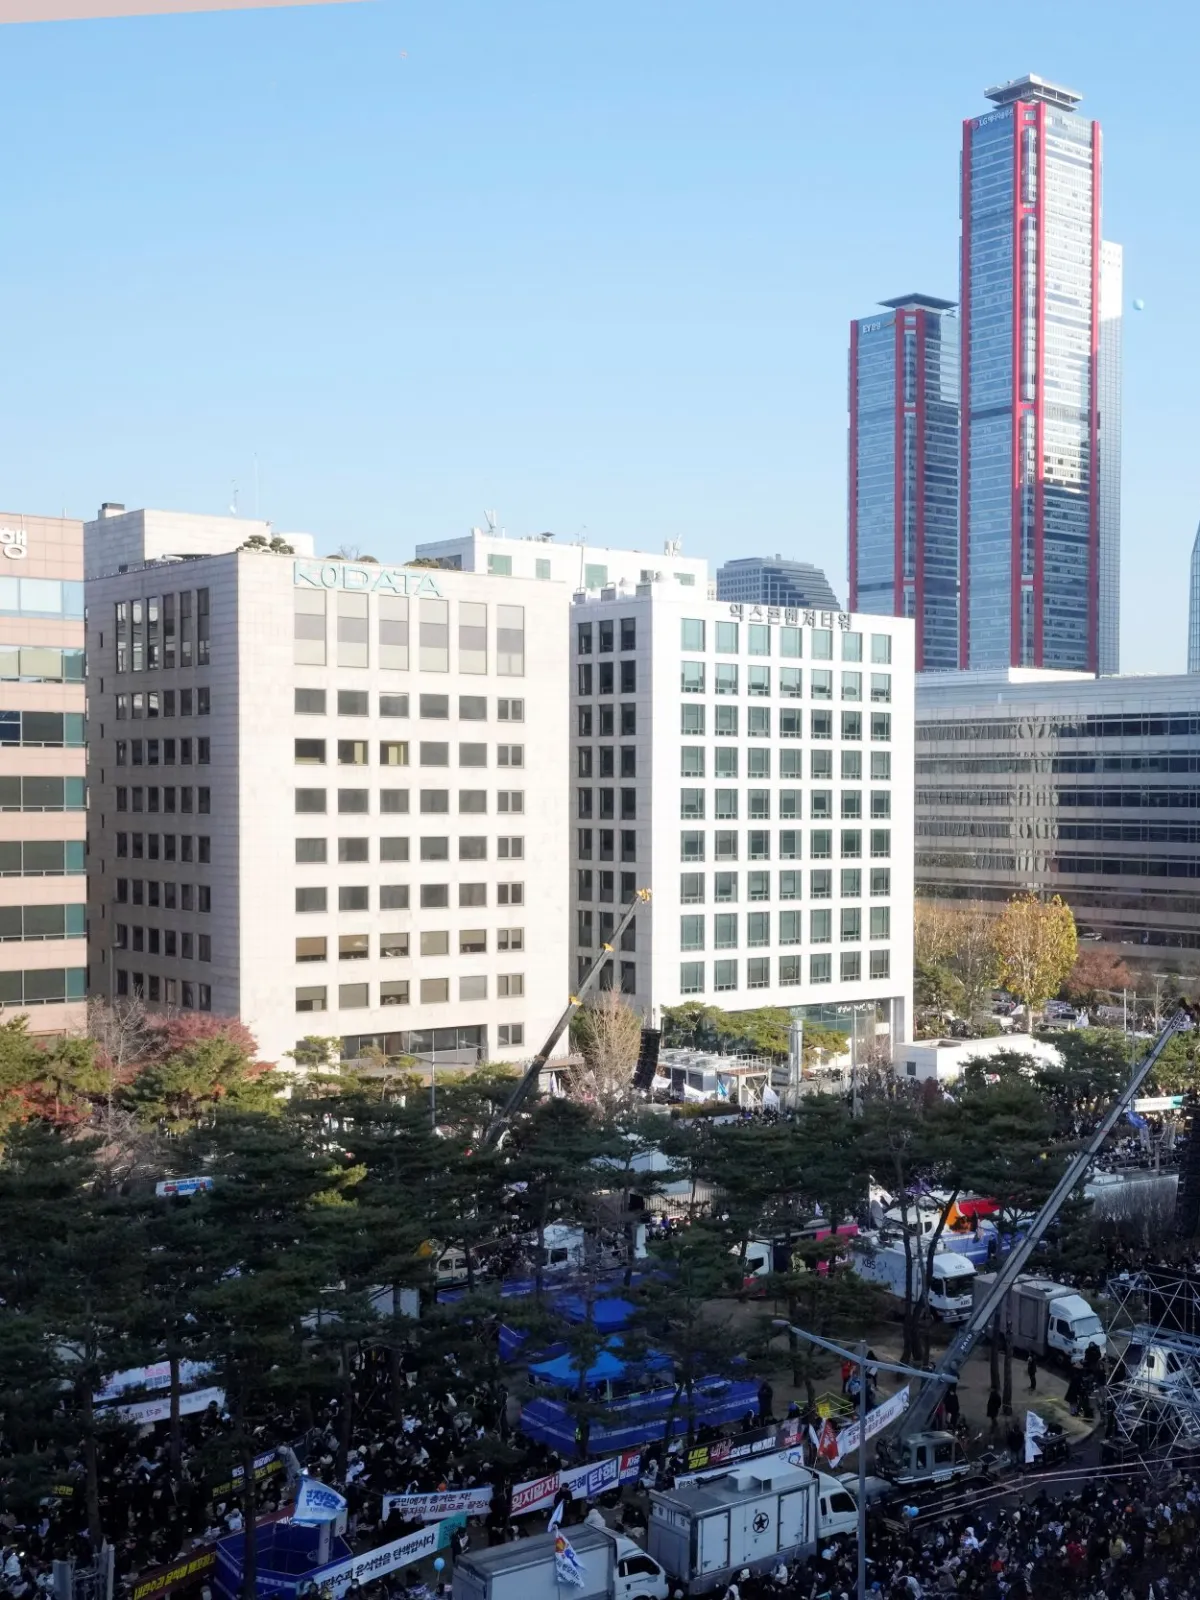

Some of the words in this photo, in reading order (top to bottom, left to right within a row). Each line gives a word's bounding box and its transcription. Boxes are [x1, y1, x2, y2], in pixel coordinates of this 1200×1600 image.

[293, 561, 444, 598] KODATA
[862, 1259, 877, 1270] KBS
[511, 1473, 559, 1512] 잊지말자!
[588, 1459, 618, 1491] 탄핵
[355, 1552, 392, 1578] 윤석열을
[392, 1532, 436, 1561] 탄핵합시다
